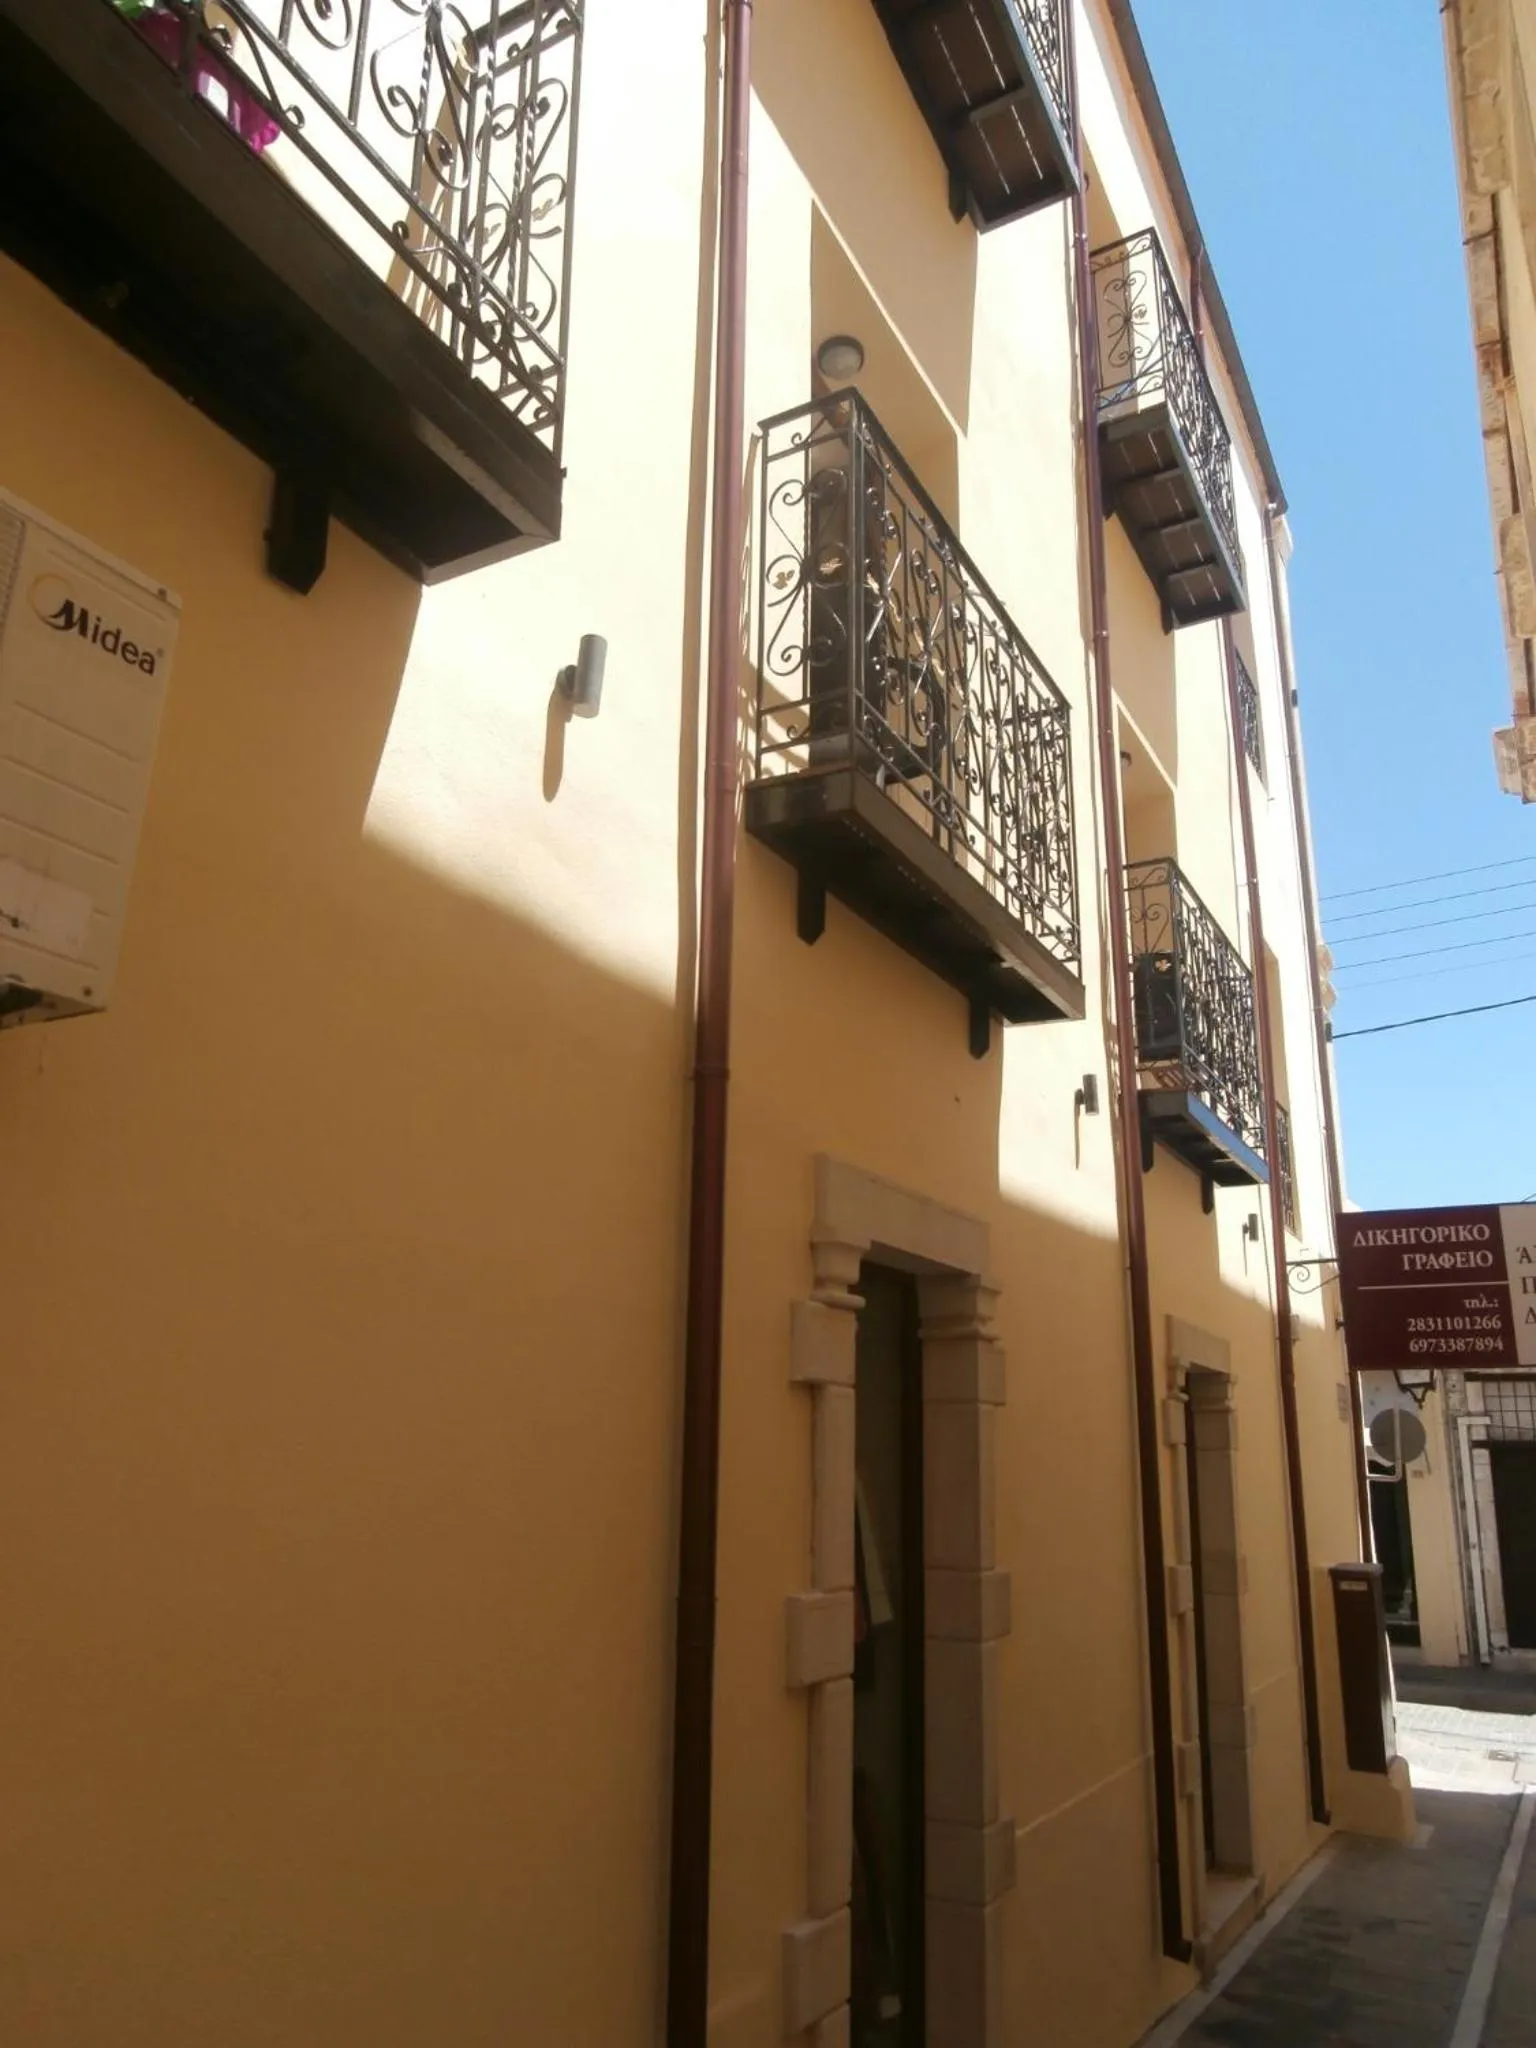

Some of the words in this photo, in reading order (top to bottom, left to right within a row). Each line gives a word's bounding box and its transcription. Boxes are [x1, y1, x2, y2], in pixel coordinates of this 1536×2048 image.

[48, 598, 156, 677] Midea
[1353, 1224, 1490, 1247] ΔΙΚΗΓΟΡΙΚΟ
[1402, 1250, 1493, 1271] ΓΡΑΦΕΙΟ
[1408, 1314, 1502, 1332] 2831101266
[1409, 1336, 1504, 1353] 6973387894
